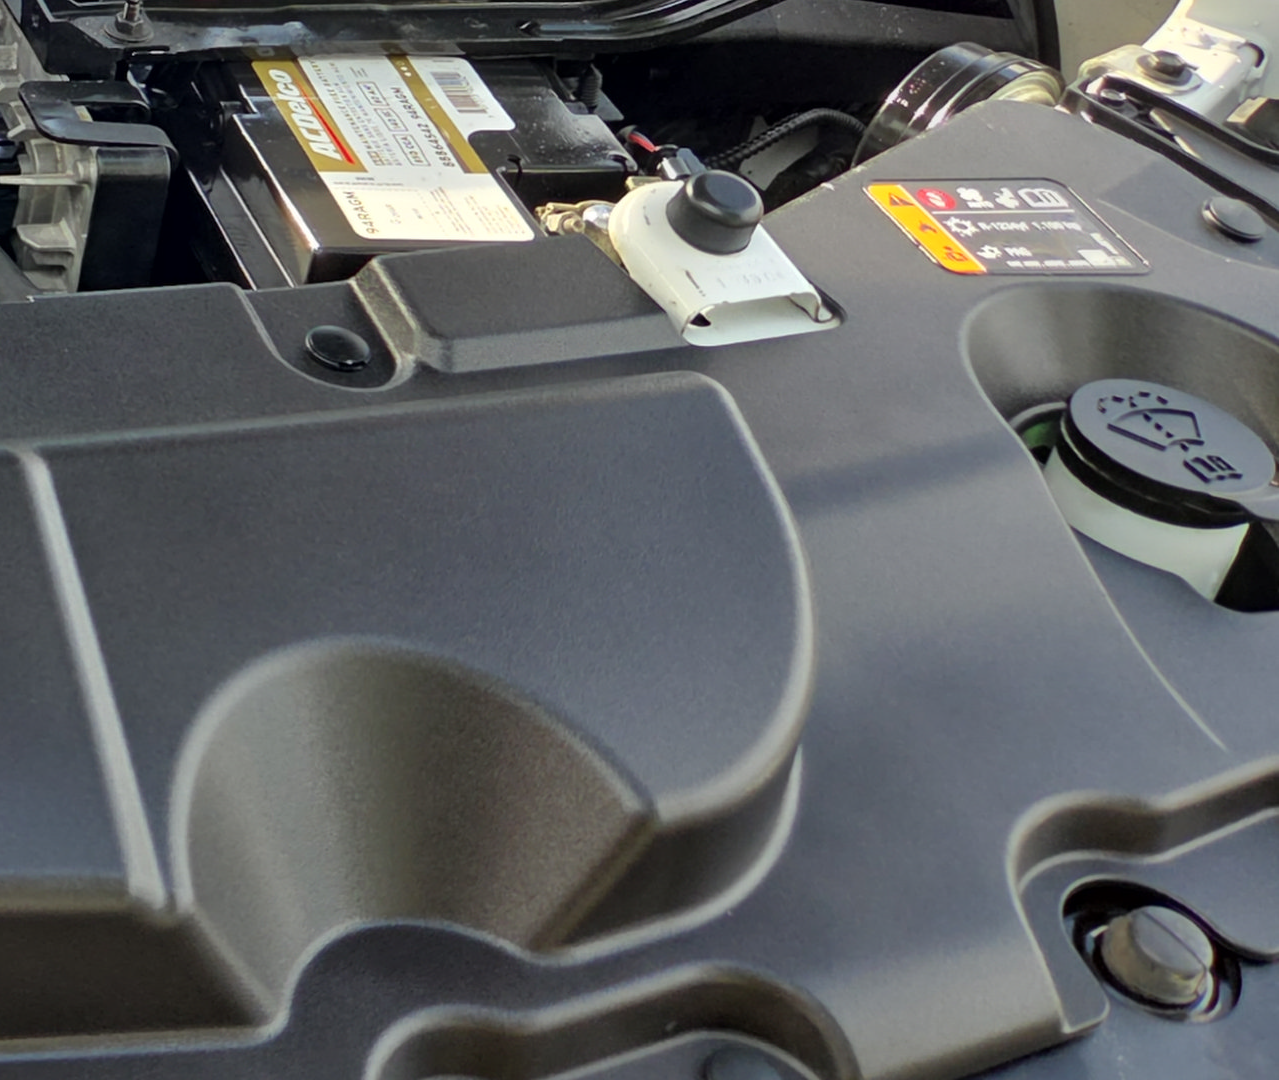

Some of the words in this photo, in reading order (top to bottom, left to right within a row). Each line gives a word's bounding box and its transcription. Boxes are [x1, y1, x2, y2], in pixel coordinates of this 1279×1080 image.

[268, 68, 343, 161] ACDelco
[390, 86, 423, 120] 94RAGM
[343, 191, 379, 235] 94RAGM
